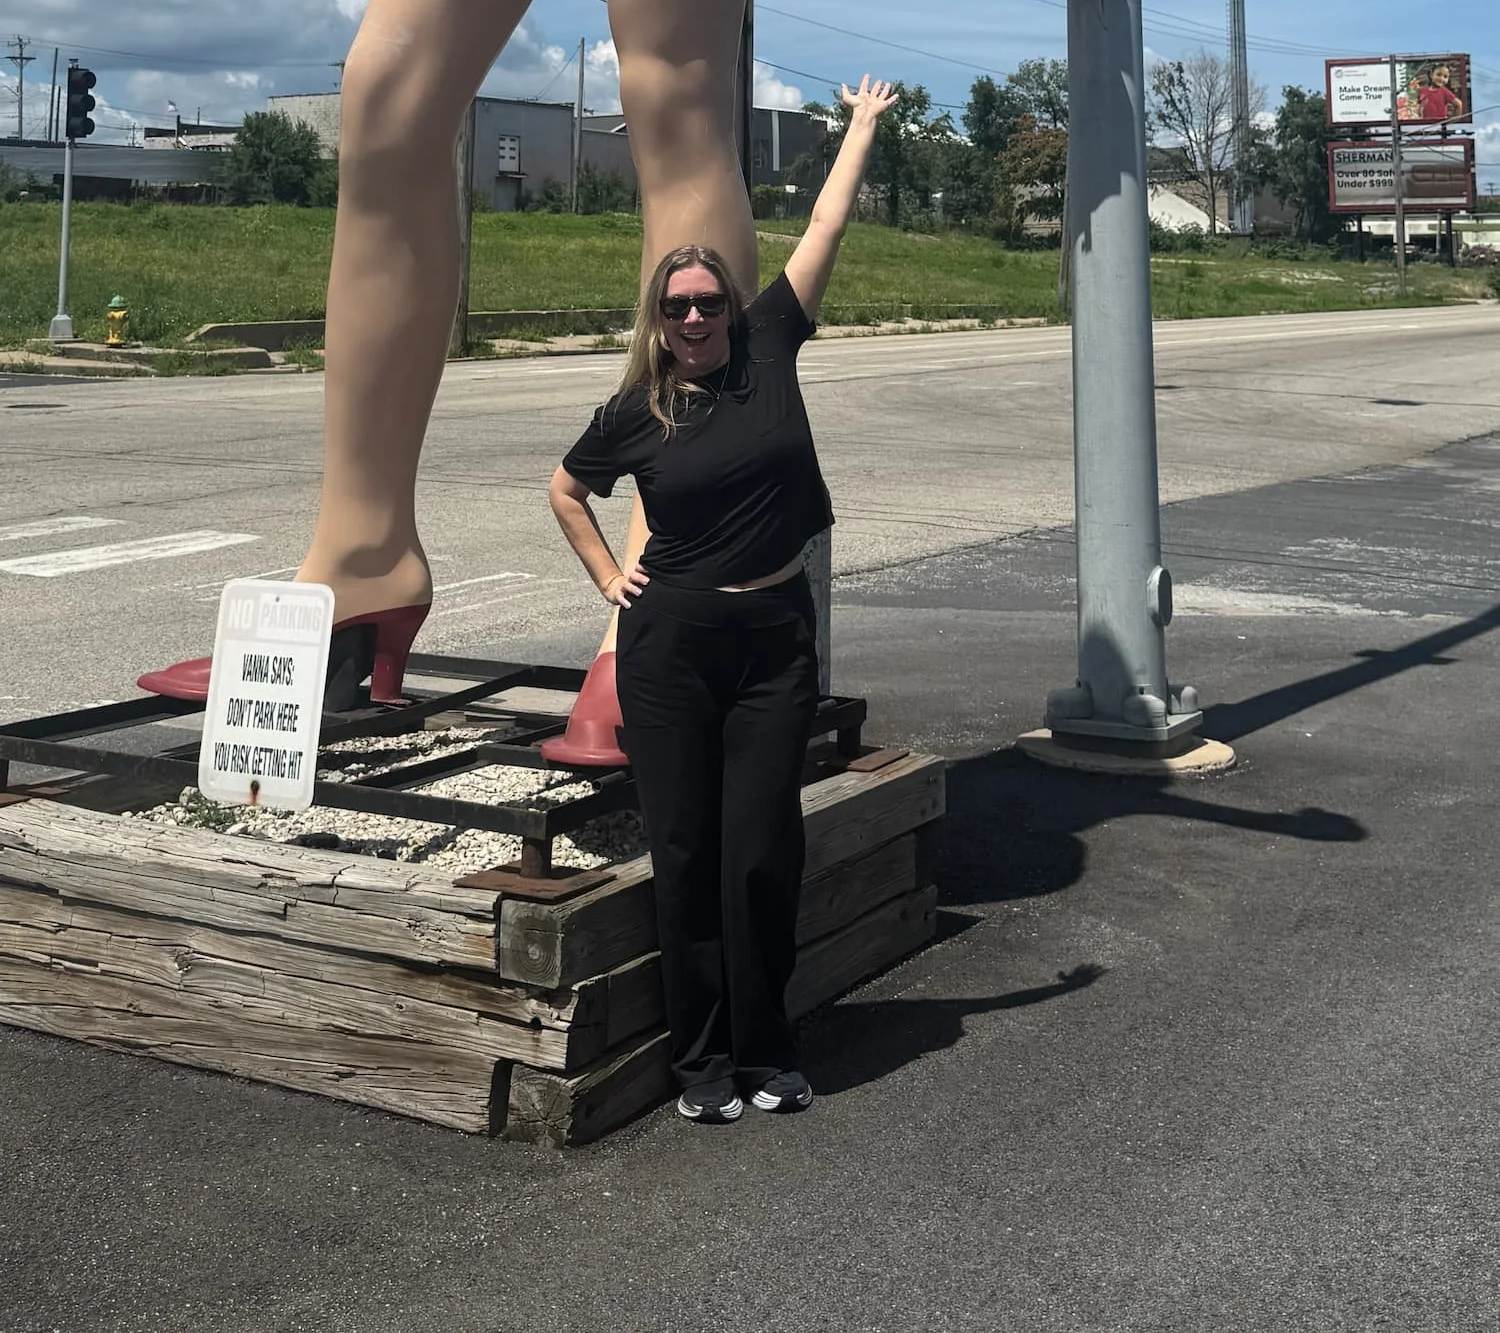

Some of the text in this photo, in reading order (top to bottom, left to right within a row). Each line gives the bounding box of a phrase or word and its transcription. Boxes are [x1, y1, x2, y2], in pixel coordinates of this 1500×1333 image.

[1337, 170, 1361, 178] Over
[1337, 179, 1393, 188] Under $999
[227, 598, 322, 632] NO PARKING
[242, 653, 295, 686] VANNA SAYS:
[226, 697, 300, 733] DON'T PARK HERE
[214, 742, 304, 781] YOU RISK GETTING HIT
